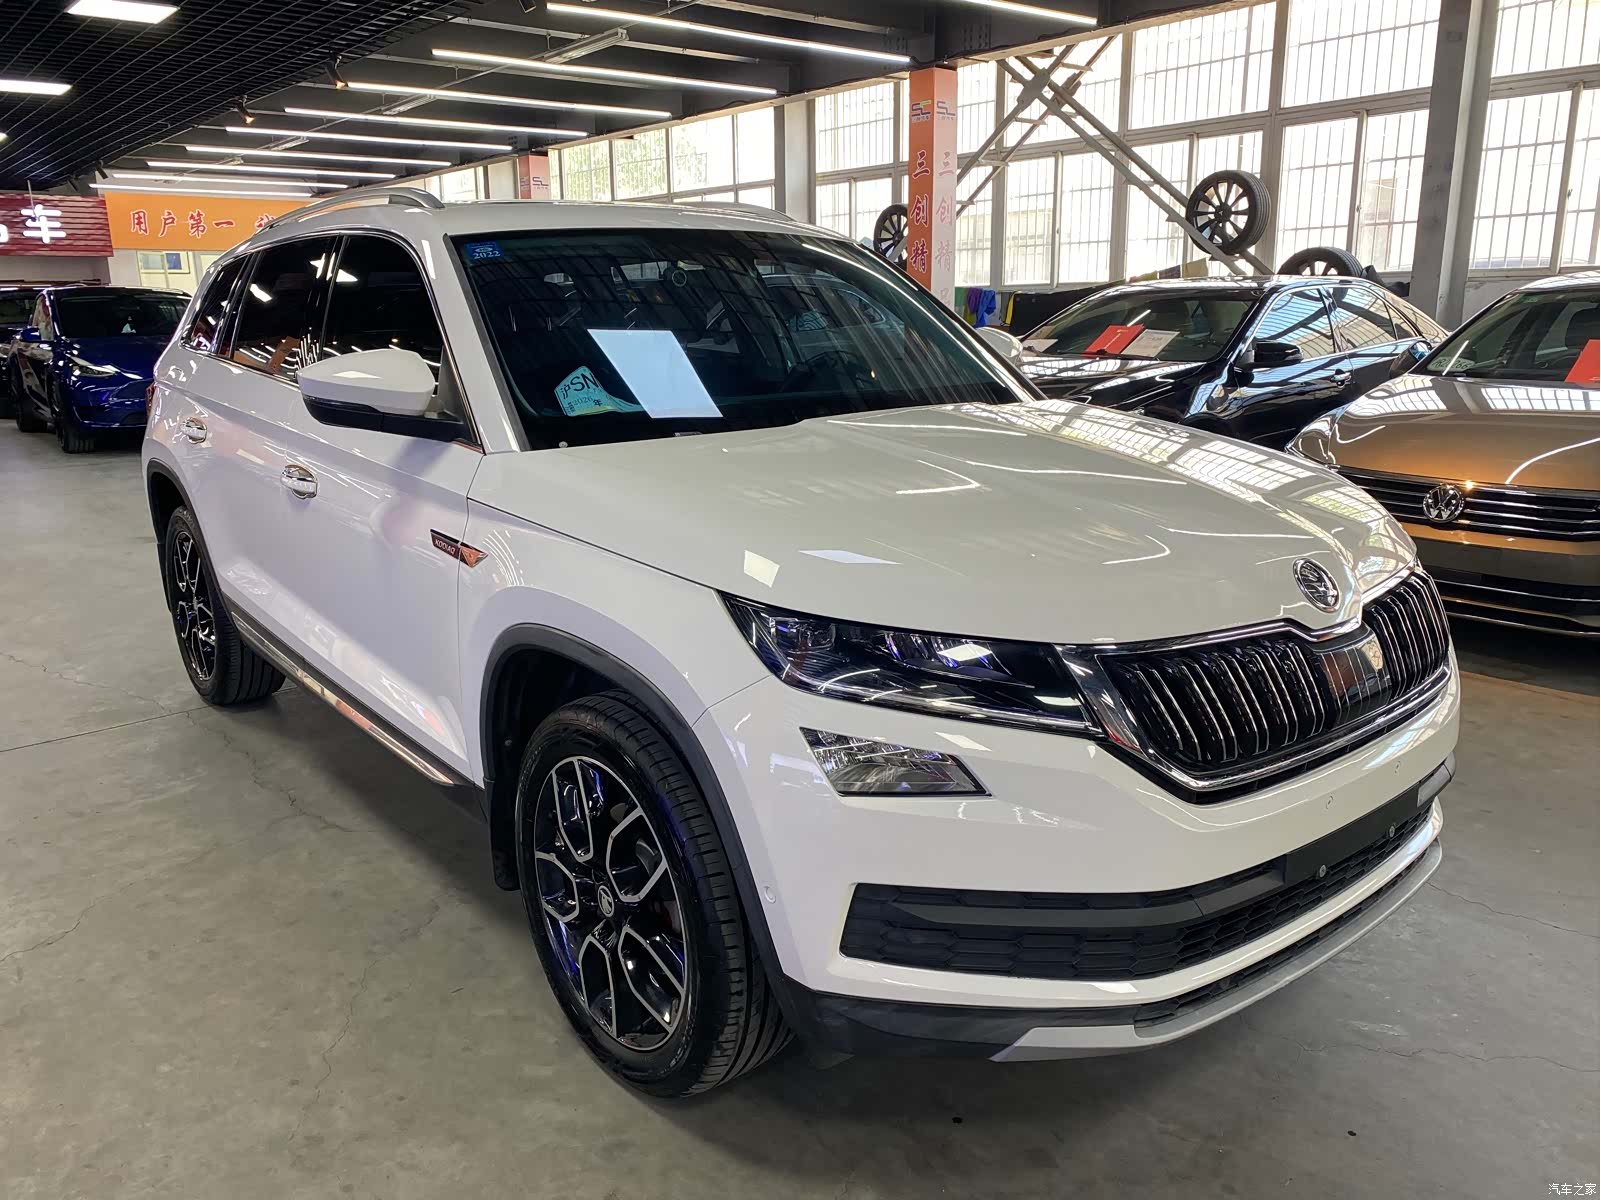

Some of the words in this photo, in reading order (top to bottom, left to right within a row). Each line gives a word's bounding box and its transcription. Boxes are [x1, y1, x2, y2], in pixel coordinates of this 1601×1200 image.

[0, 203, 67, 244] 车
[130, 209, 236, 238] 用户第一
[472, 250, 501, 260] 2022
[435, 539, 456, 556] KODIAQ
